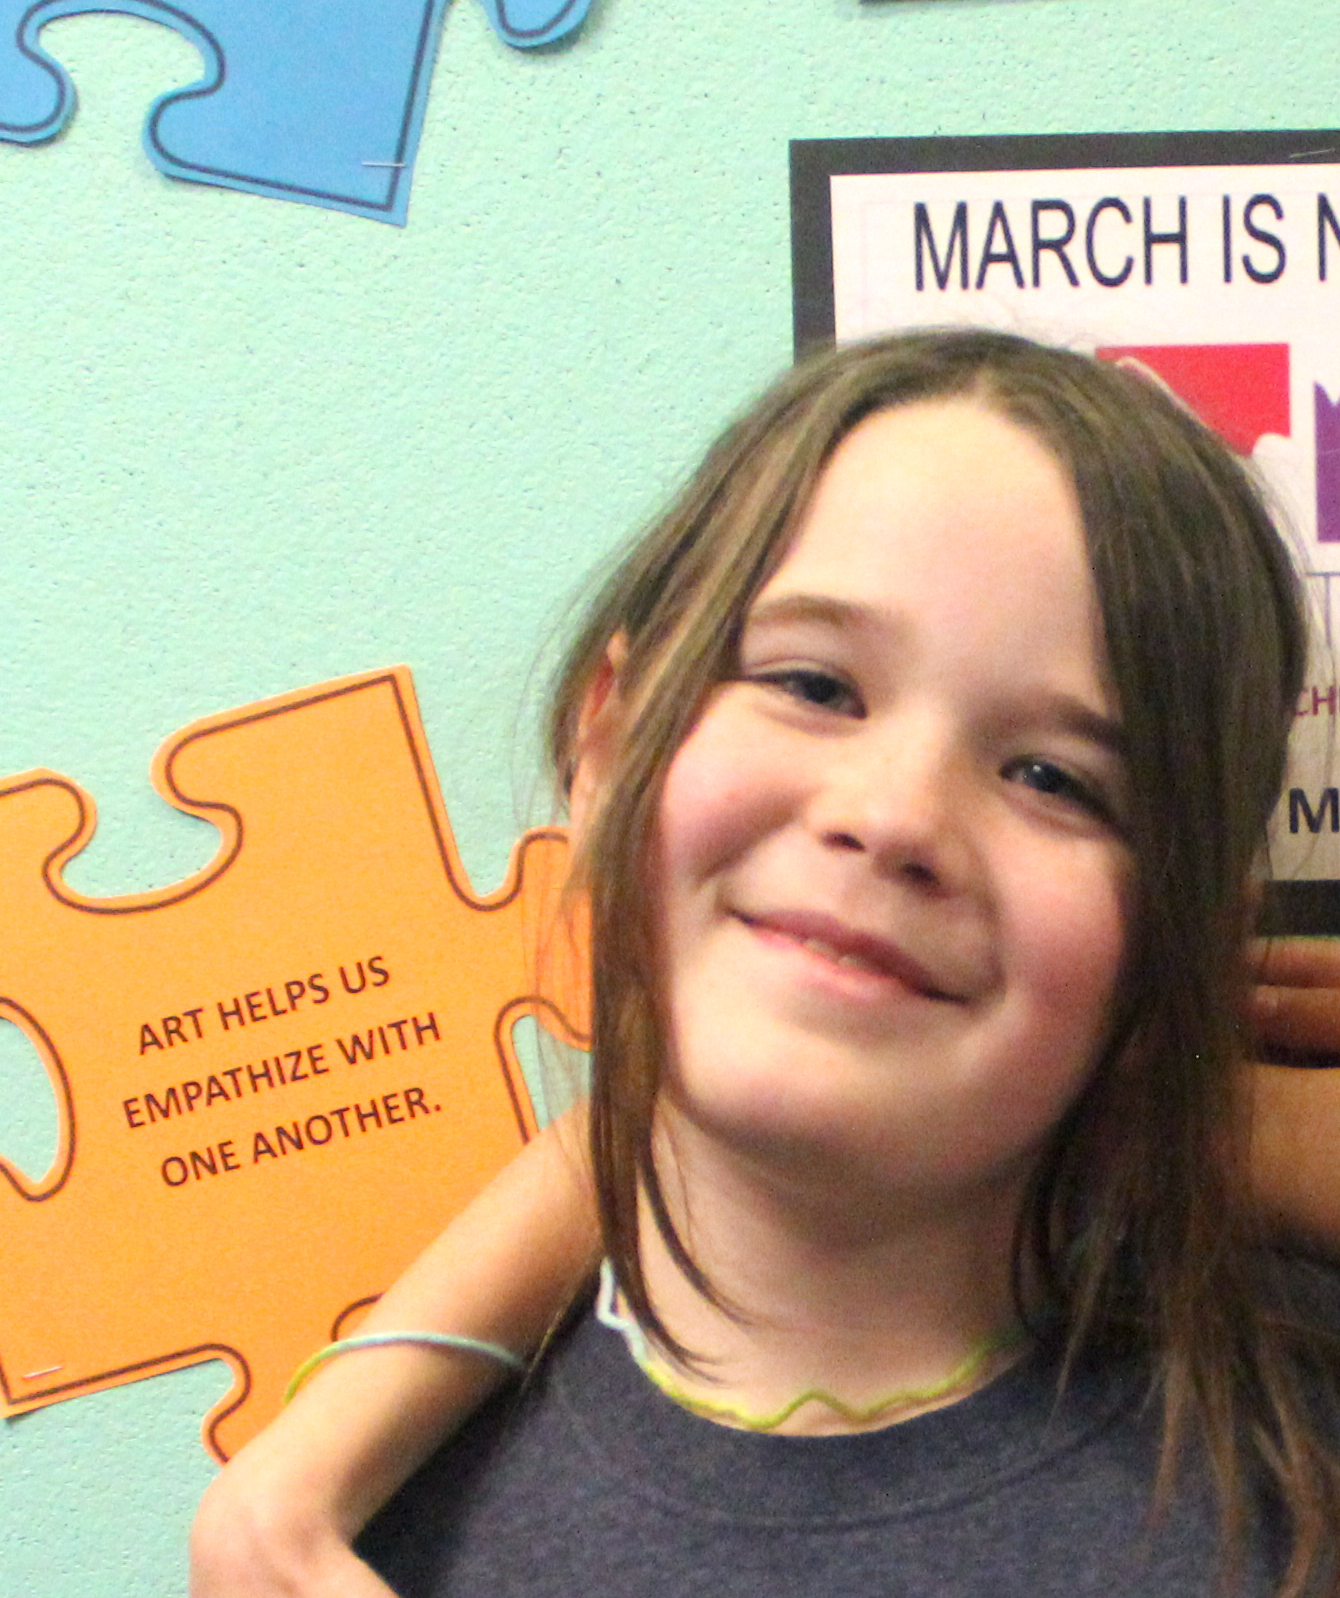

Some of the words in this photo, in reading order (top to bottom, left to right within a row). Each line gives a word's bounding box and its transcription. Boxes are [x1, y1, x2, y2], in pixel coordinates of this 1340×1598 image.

[912, 196, 1188, 292] MARCH
[1222, 193, 1287, 284] IS
[139, 1007, 205, 1056] ART
[216, 972, 331, 1031] HELPS
[338, 955, 391, 995] US
[122, 1043, 331, 1130] EMPATHIZE
[335, 1011, 442, 1066] WITH
[160, 1140, 242, 1189] ONE
[251, 1086, 442, 1165] ANOTHER.
